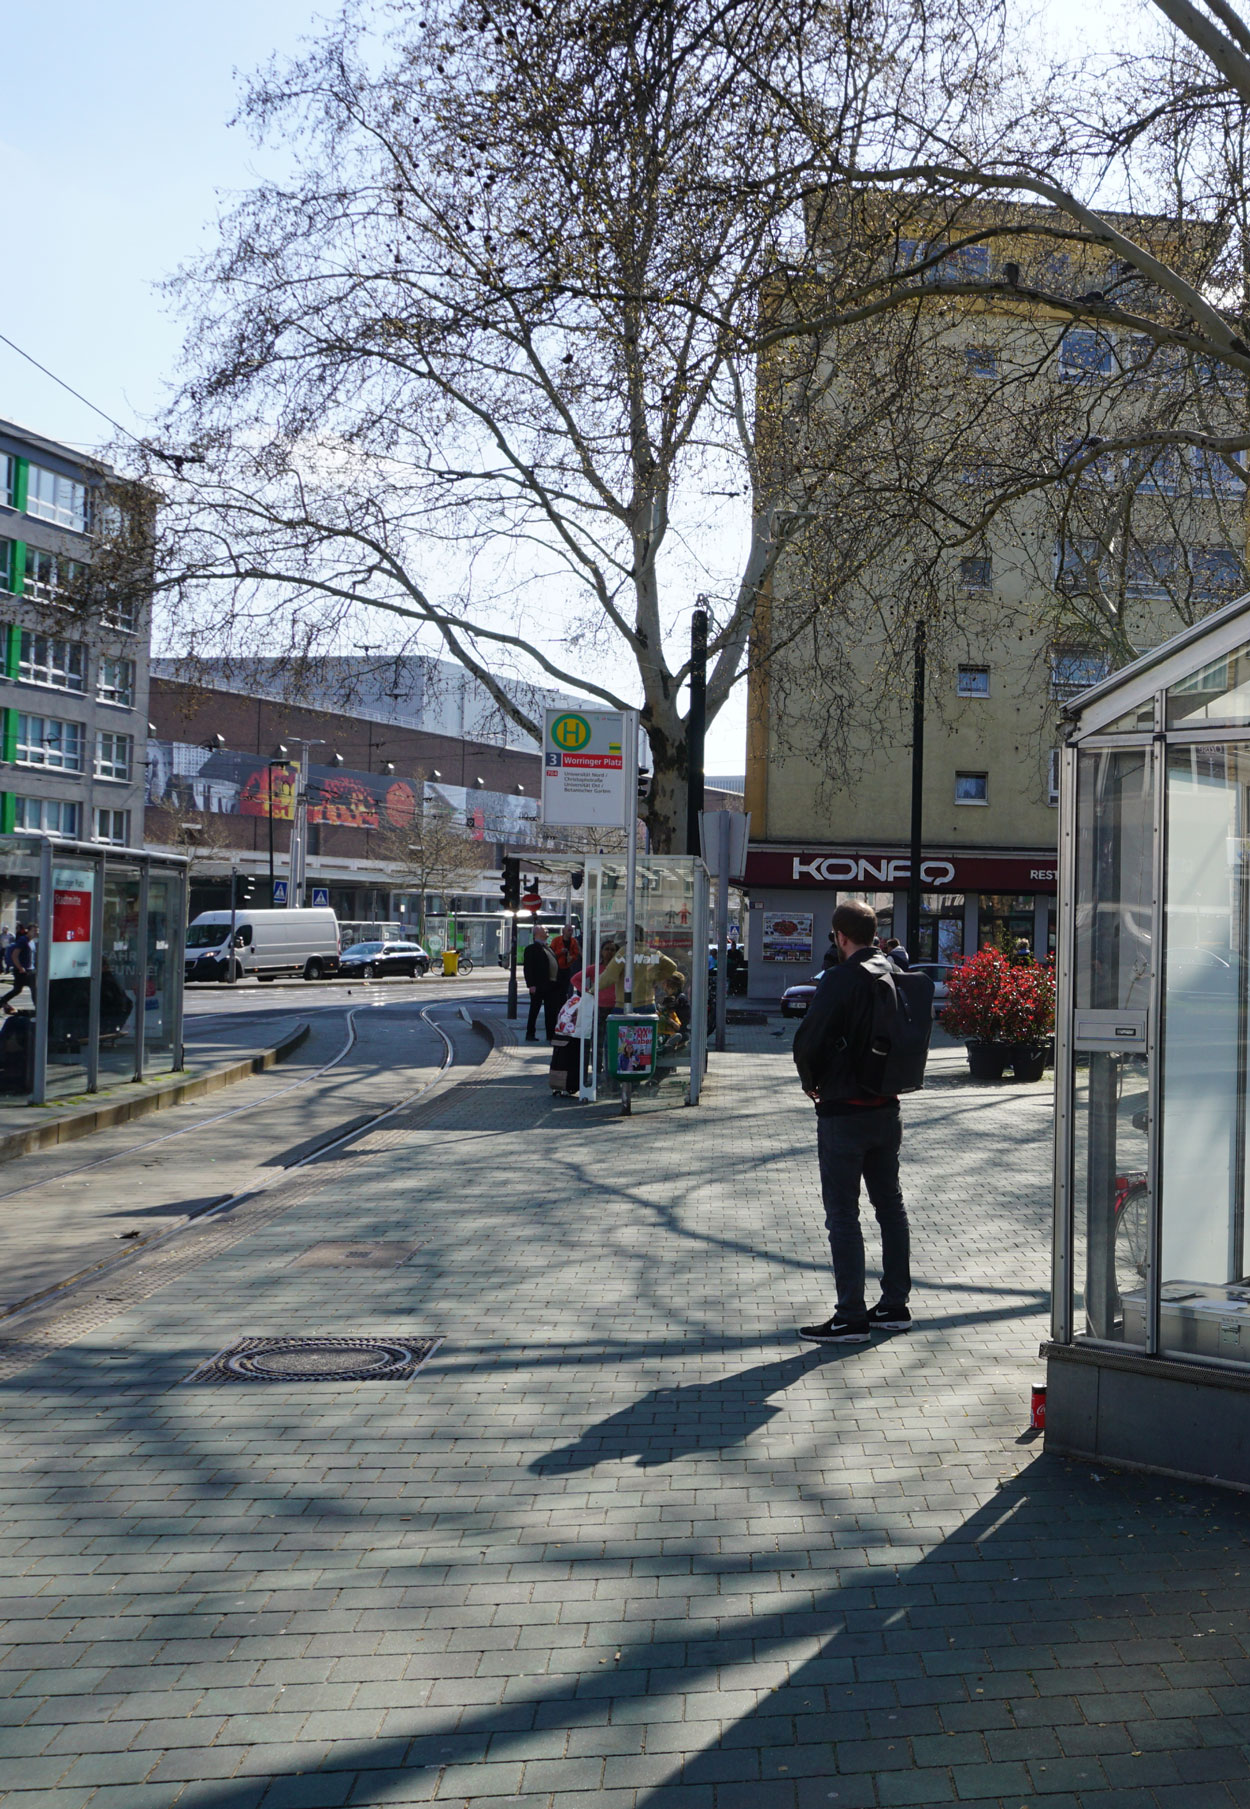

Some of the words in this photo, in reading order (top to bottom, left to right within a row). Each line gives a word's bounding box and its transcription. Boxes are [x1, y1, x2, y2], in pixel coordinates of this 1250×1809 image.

[549, 754, 557, 766] 3
[564, 756, 602, 767] Worringer
[604, 758, 622, 766] Platz
